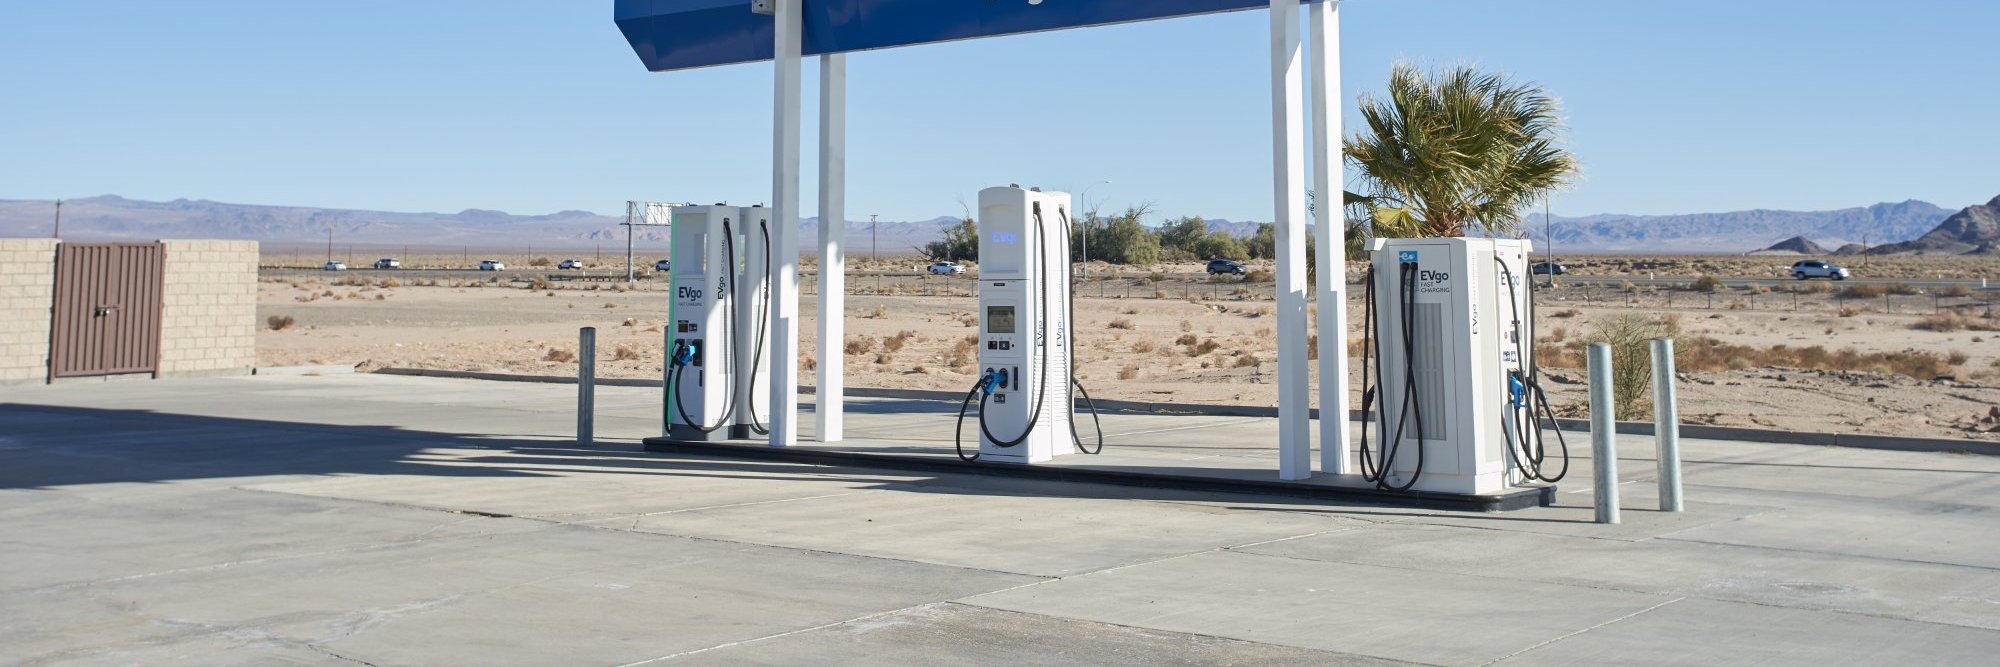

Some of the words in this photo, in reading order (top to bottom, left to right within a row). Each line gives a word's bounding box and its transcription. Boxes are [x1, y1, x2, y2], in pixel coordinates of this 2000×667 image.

[1420, 270, 1449, 283] EVgo
[678, 286, 702, 301] EVgo
[717, 276, 726, 300] EVgo
